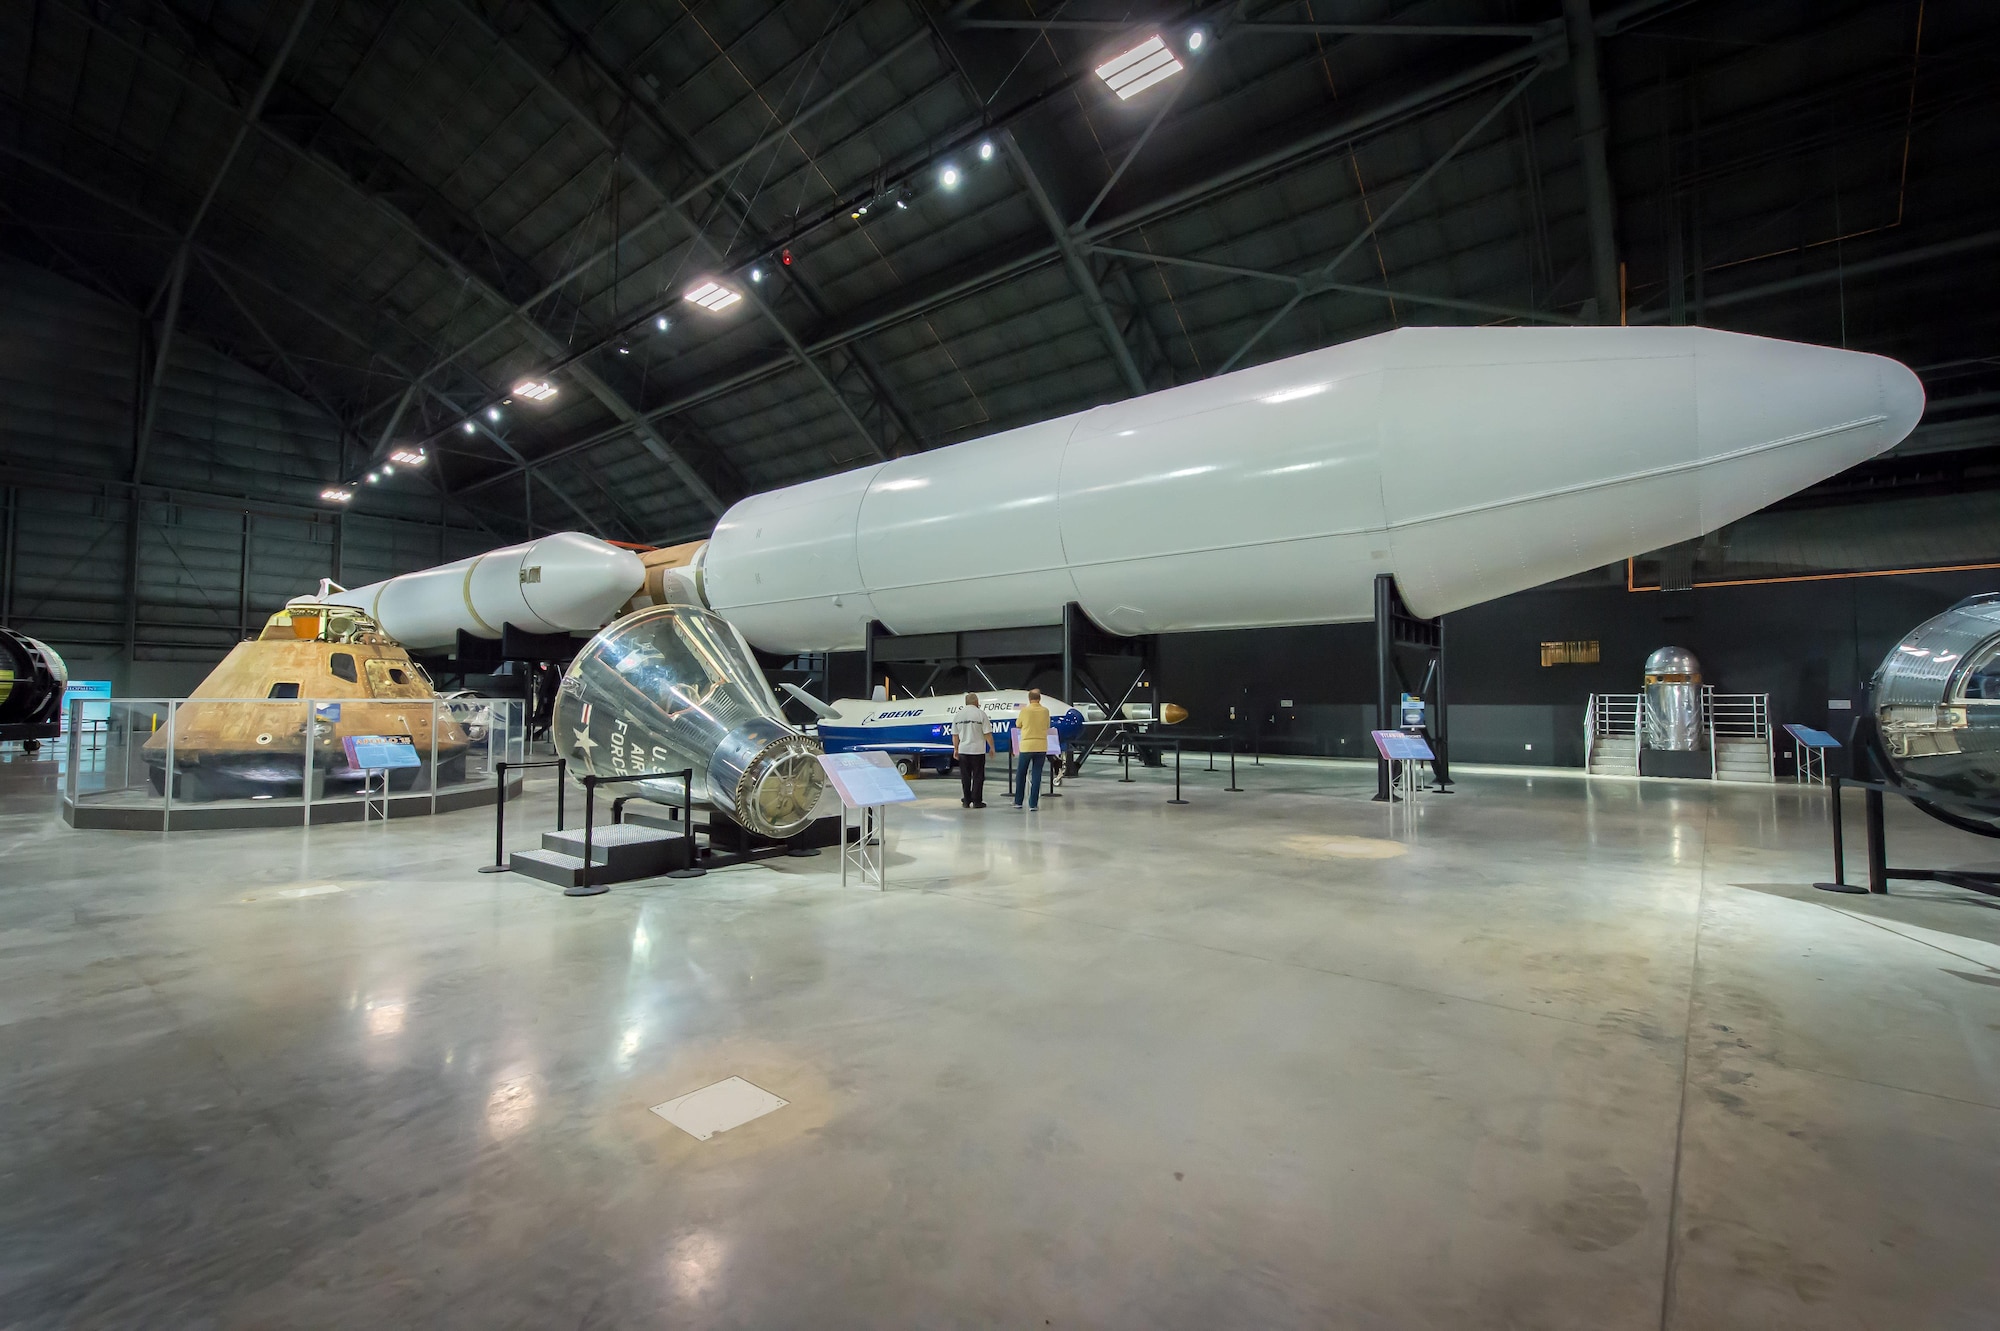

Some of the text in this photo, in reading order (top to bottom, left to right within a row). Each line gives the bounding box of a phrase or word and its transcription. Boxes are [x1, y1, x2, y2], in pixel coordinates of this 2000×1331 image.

[878, 709, 923, 719] BOEING
[983, 702, 1013, 711] FORCE
[610, 719, 628, 776] FORCE
[630, 742, 645, 773] AIR
